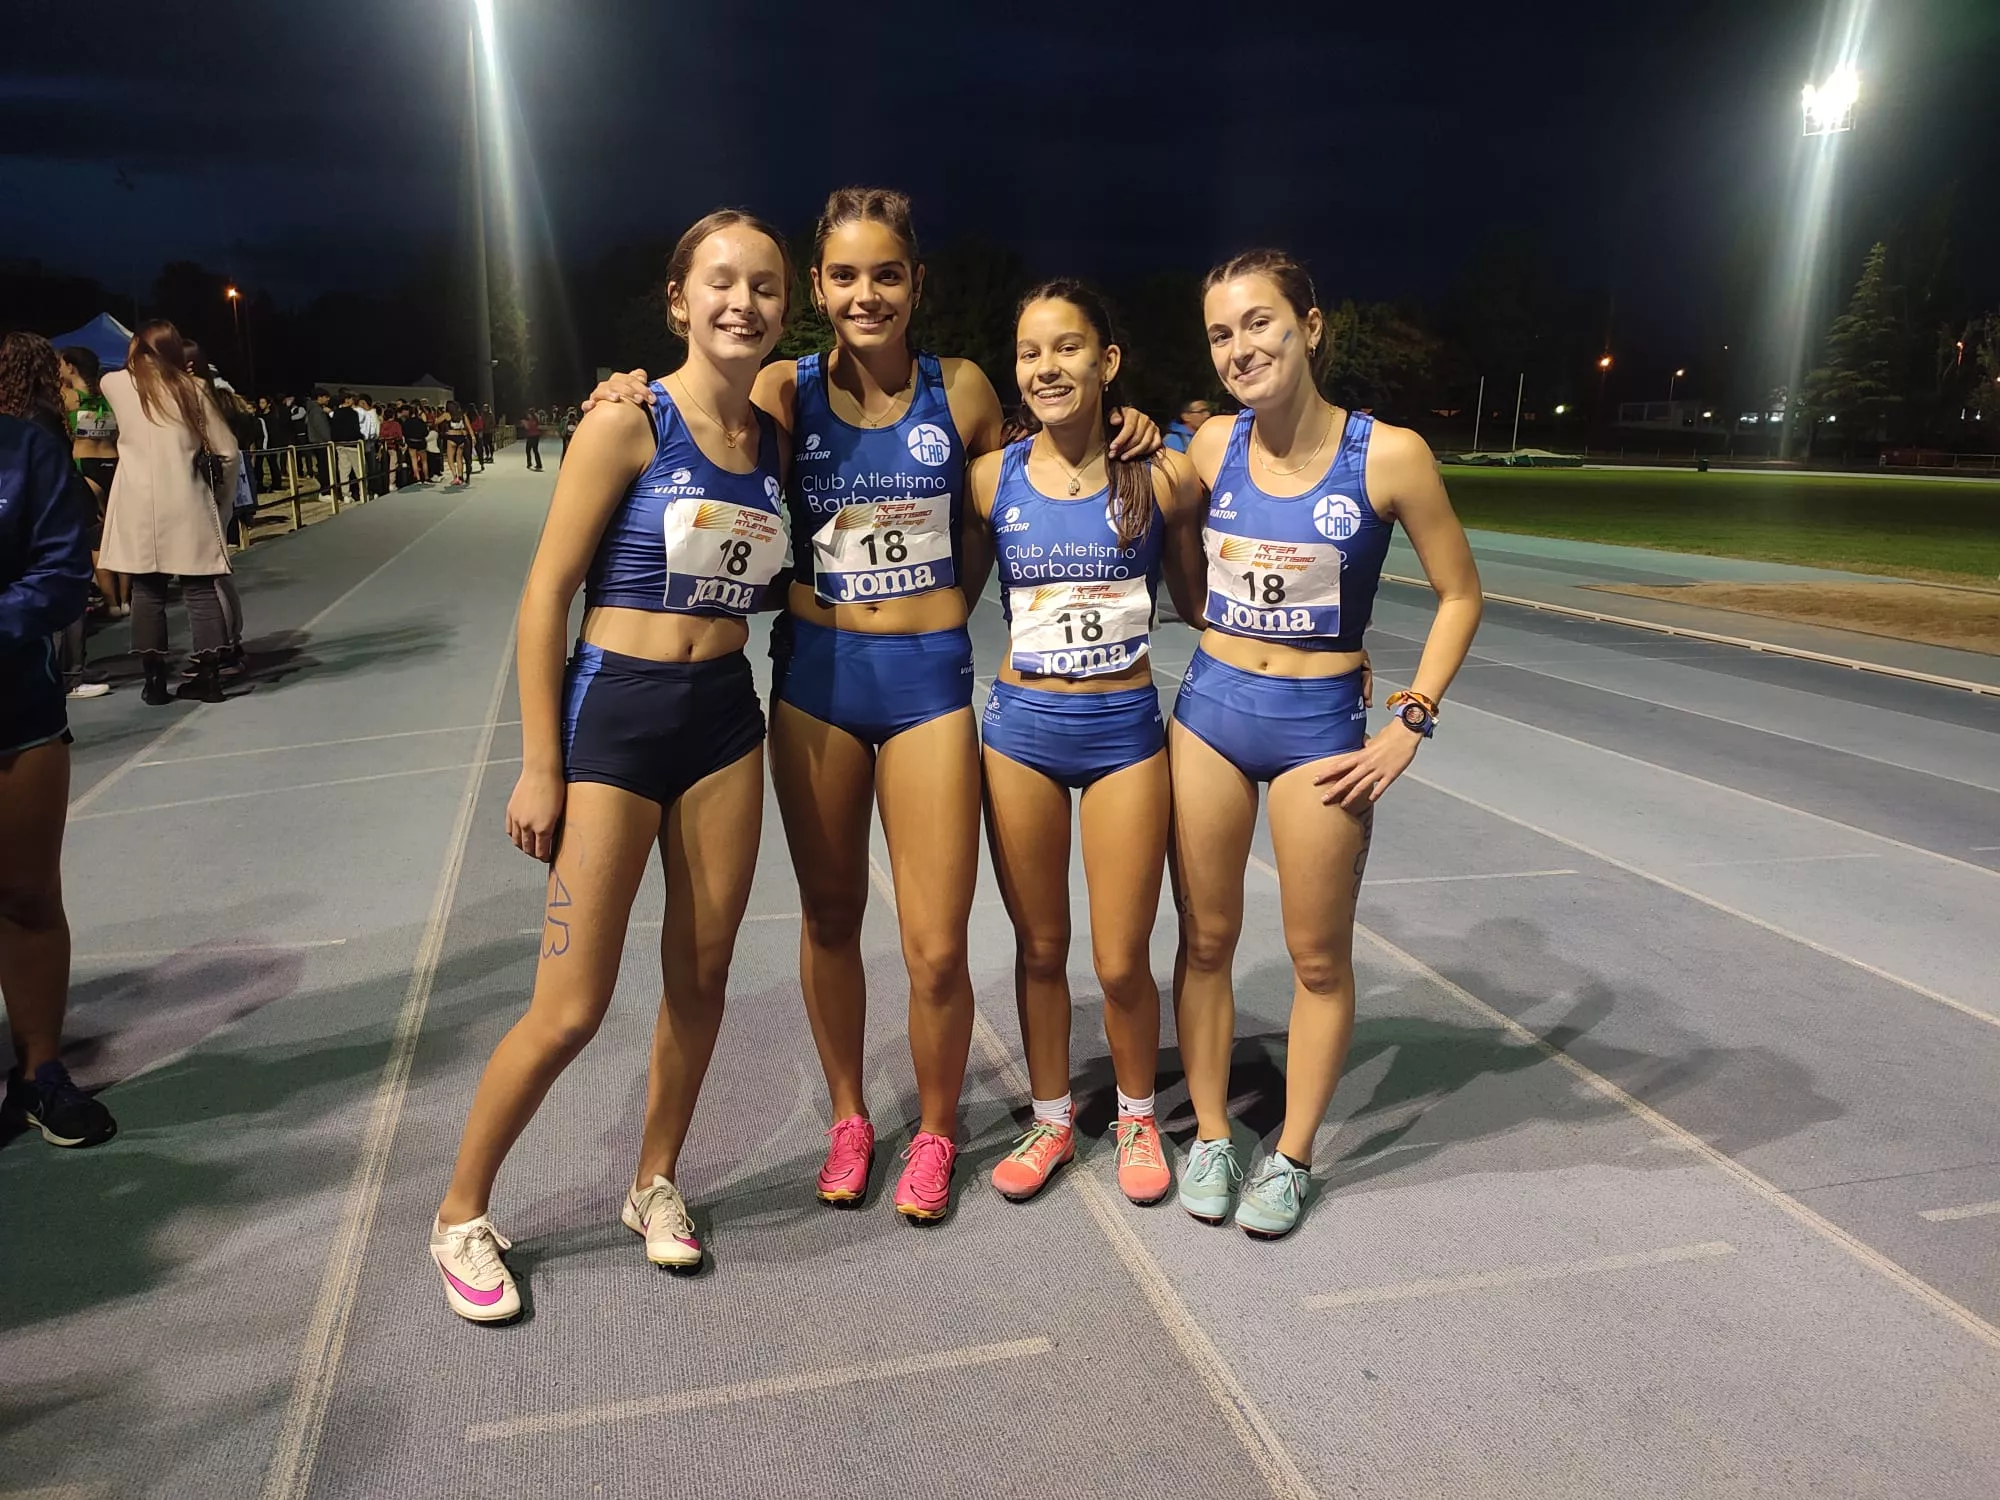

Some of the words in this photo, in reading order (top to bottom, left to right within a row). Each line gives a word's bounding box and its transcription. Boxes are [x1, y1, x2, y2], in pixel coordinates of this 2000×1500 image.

[919, 444, 944, 463] CAB
[654, 485, 705, 496] VIATOR
[802, 473, 845, 492] Club
[852, 472, 946, 489] Atletismo
[737, 509, 768, 523] RFEA
[875, 502, 916, 514] RFEA
[1325, 516, 1352, 537] CAB
[860, 530, 908, 565] 18
[1005, 543, 1044, 560] Club
[1049, 542, 1136, 559] Atletismo
[1258, 543, 1298, 554] RFEA
[717, 539, 752, 576] 18
[1254, 553, 1317, 563] ATLETISMO
[1010, 559, 1129, 580] Barbastro
[1071, 585, 1111, 594] RFEA
[1241, 571, 1286, 604] 18
[1056, 610, 1104, 644] 18
